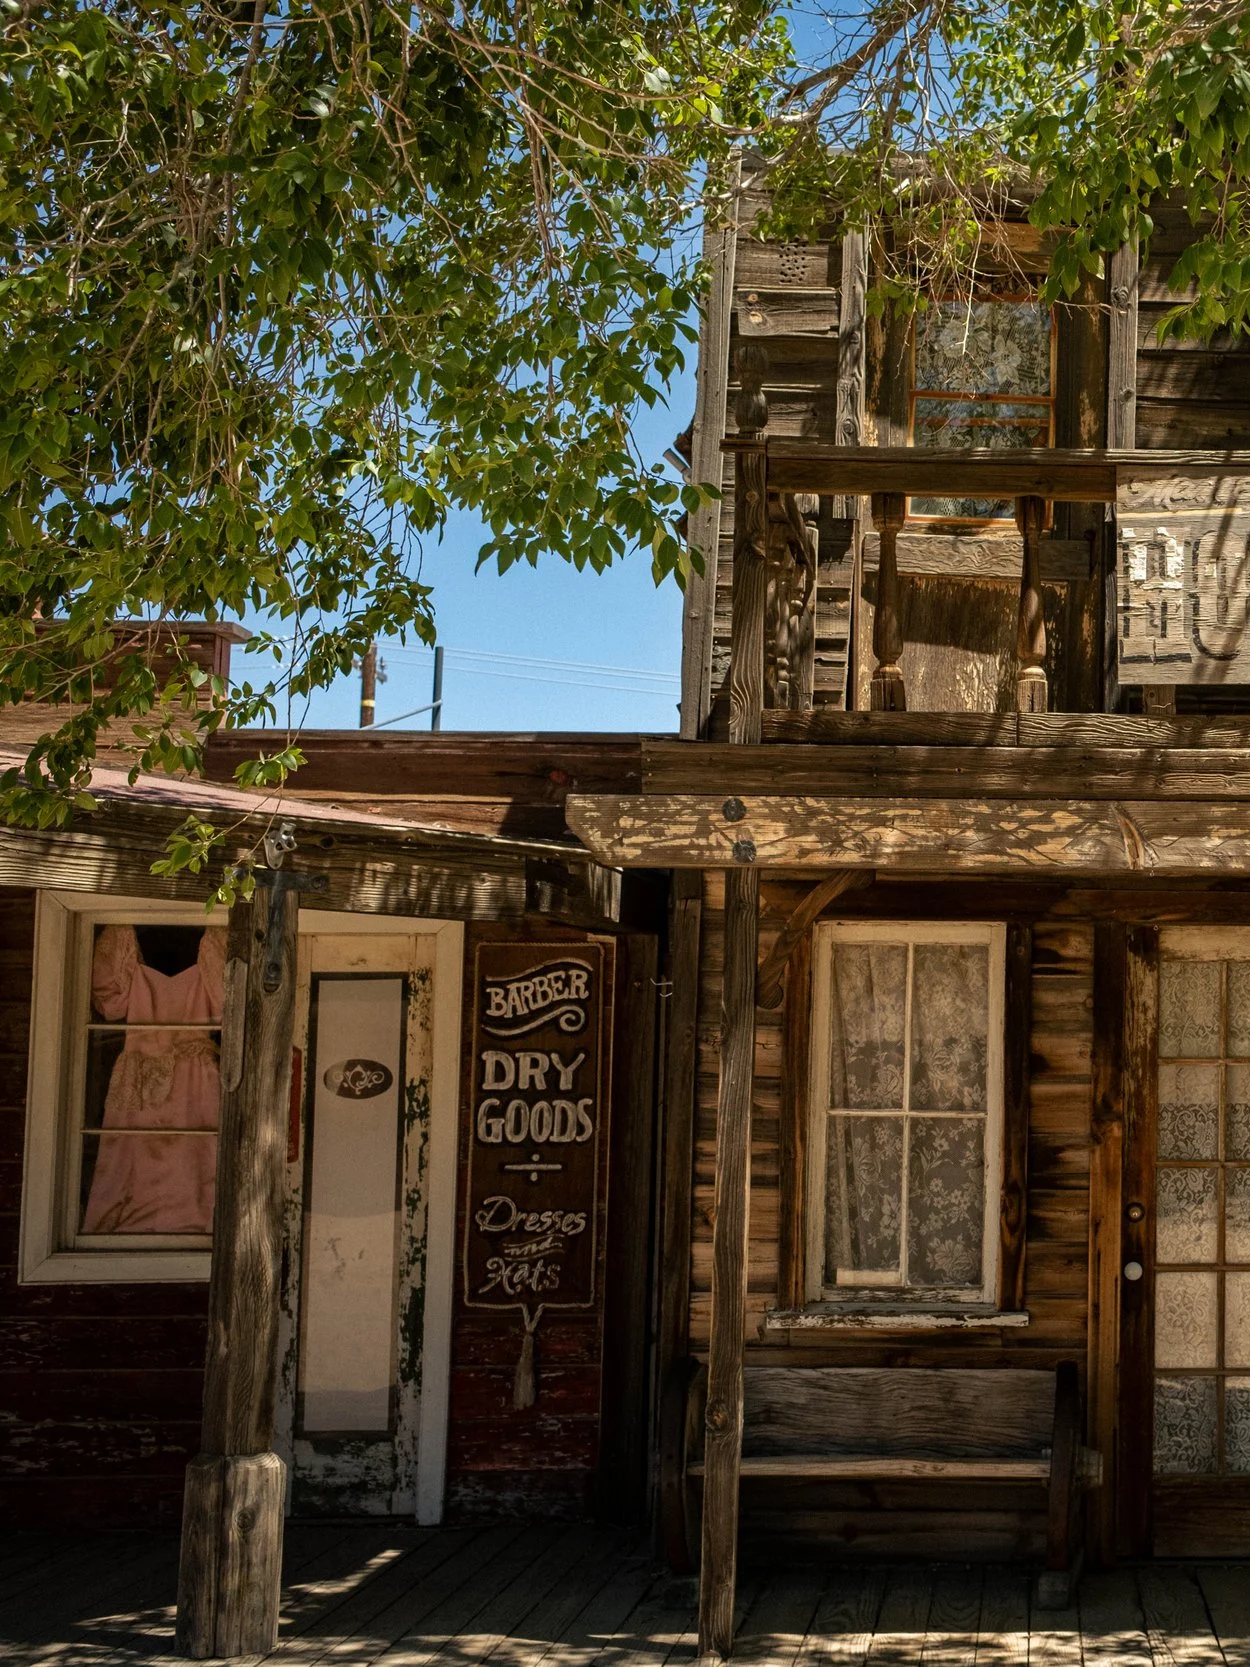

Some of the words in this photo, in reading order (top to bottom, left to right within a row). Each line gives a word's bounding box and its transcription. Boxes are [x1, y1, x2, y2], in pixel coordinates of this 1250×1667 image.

[485, 969, 589, 1018] BARBER
[481, 1050, 586, 1090] DRY
[477, 1098, 593, 1143] GOODS
[475, 1196, 587, 1235] Dresses
[478, 1257, 561, 1295] Hats
